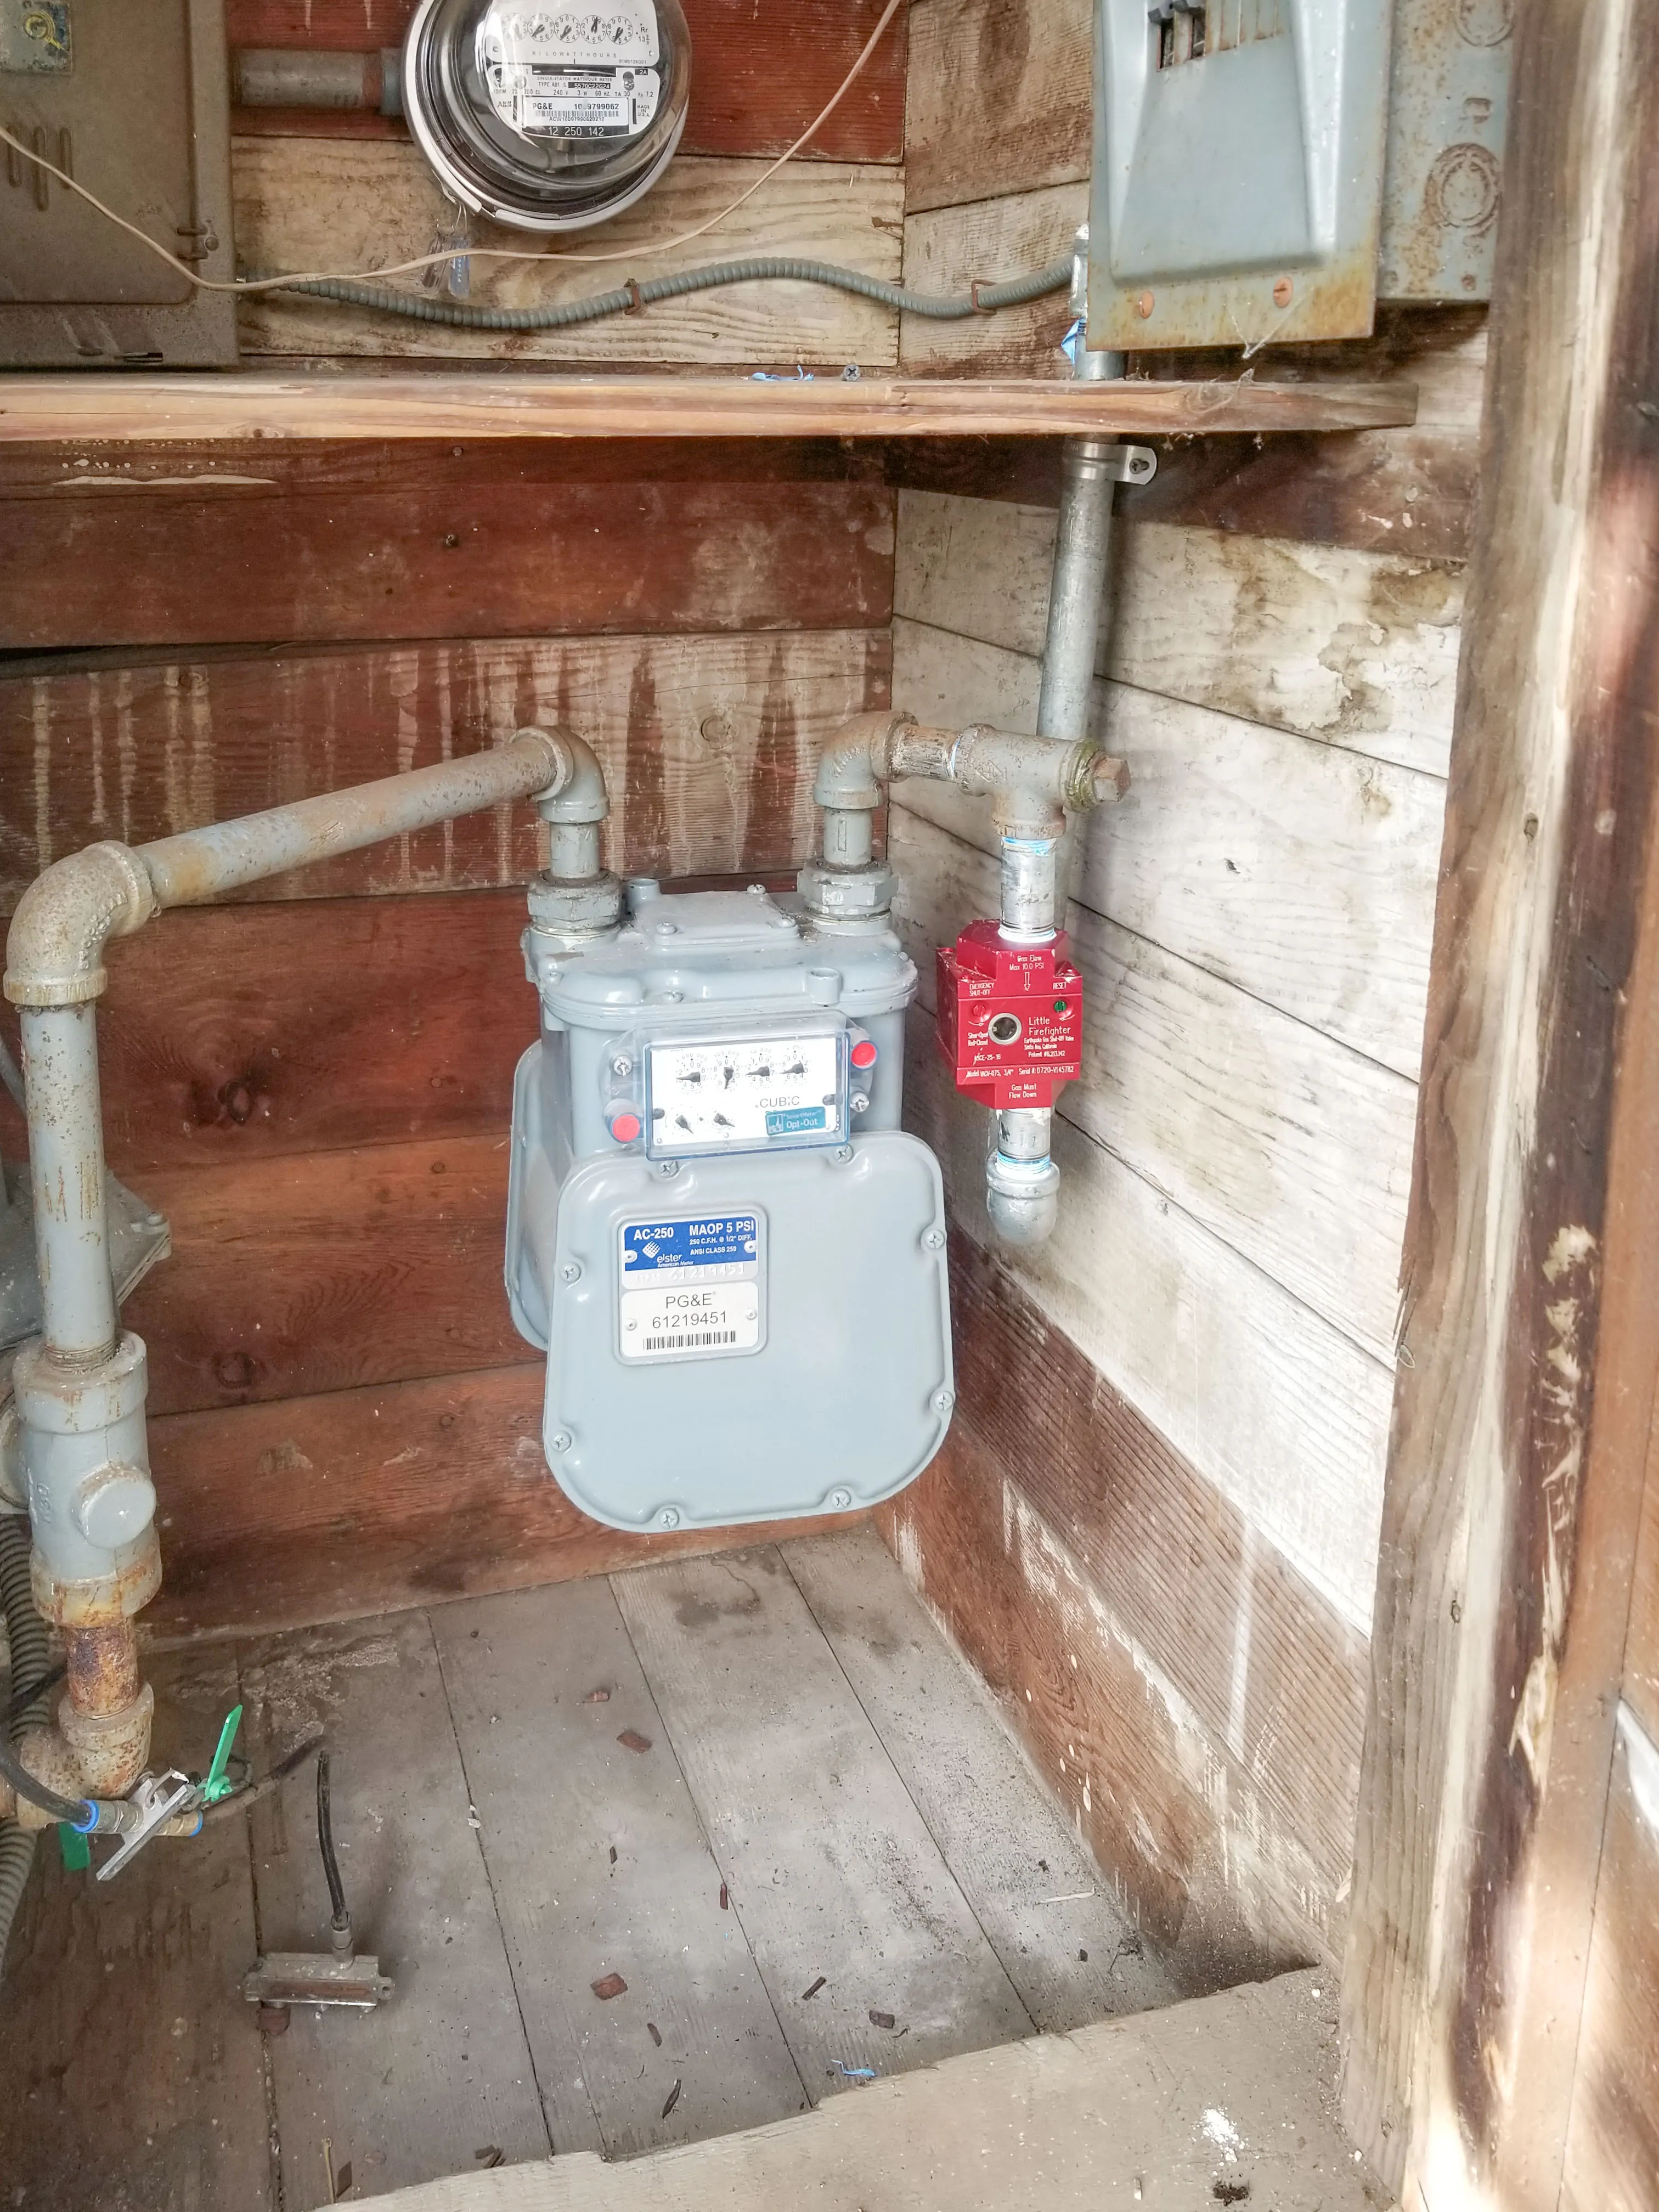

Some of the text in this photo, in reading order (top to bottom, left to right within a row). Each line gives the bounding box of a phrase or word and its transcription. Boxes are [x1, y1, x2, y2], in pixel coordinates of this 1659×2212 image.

[549, 127, 604, 136] 12 250 142
[1053, 982, 1067, 990] RESET
[1029, 1016, 1050, 1025] Little
[1029, 1026, 1071, 1036] Firefighter
[760, 1096, 800, 1108] CUBIC
[786, 1118, 818, 1129] Opt-Out
[634, 1220, 754, 1241] AC-250 MAOP 5 PSI
[657, 1253, 682, 1263] elster
[666, 1293, 712, 1309] PG&E
[652, 1310, 726, 1329] 61219451
